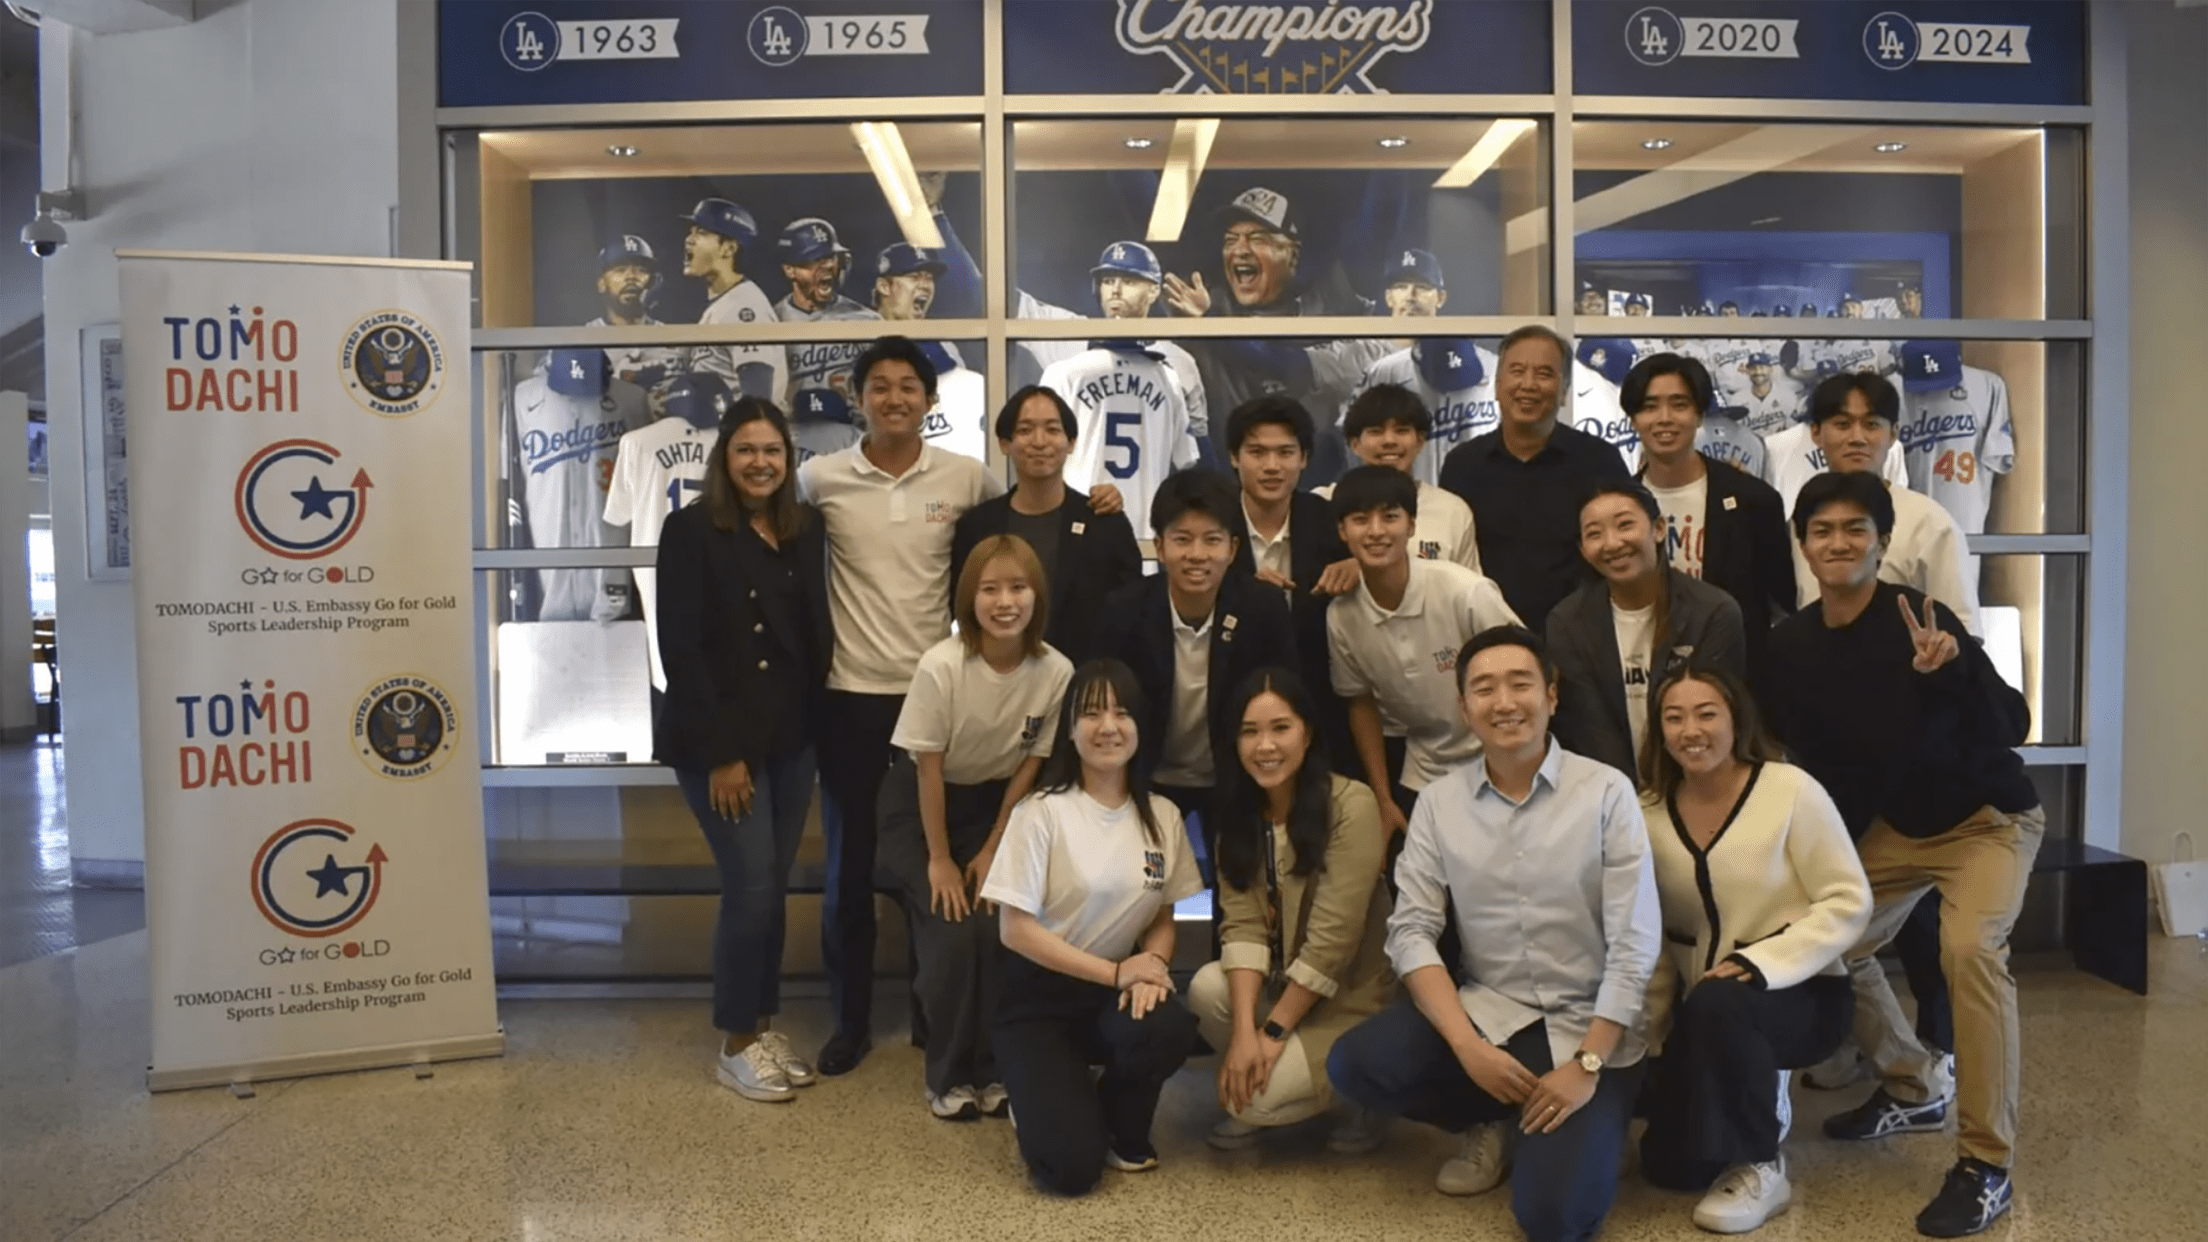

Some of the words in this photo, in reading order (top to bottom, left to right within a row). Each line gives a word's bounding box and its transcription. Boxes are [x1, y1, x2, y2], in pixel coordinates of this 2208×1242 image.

[574, 25, 658, 53] 1963
[823, 21, 907, 49] 1965
[1127, 0, 1423, 57] Champions
[1696, 23, 1781, 52] 2020
[1932, 29, 2013, 57] 2024
[163, 305, 298, 362] TOMO
[359, 314, 398, 332] STATES
[401, 316, 415, 326] OF
[788, 343, 862, 383] odgers
[166, 367, 298, 412] DACHI
[1077, 373, 1166, 411] FREEMAN
[369, 400, 419, 413] EMBASSY
[1434, 397, 1498, 443] dgers
[522, 418, 626, 465] Dodgers
[1104, 412, 1142, 479] 5
[1899, 410, 1976, 452] odgers
[655, 441, 709, 469] OHTA
[1934, 450, 1976, 484] 49
[283, 567, 303, 582] for
[156, 601, 254, 617] TOMODACHI
[272, 600, 301, 614] U.S.
[306, 598, 370, 616] Embassy
[374, 599, 394, 611] Go
[398, 596, 420, 610] for
[423, 596, 456, 610] Gold
[208, 619, 256, 636] Sports
[260, 616, 342, 635] Leadership
[347, 615, 410, 632] Program
[371, 678, 409, 697] STATES
[412, 679, 427, 688] OF
[176, 679, 310, 738] TOMO
[179, 741, 312, 790] DACHI
[382, 762, 431, 777] EMBASSY
[300, 946, 320, 961] for
[174, 986, 272, 1007] TOMODACHI
[290, 982, 319, 997] U.S.
[323, 977, 387, 997] Embassy
[391, 974, 411, 988] Go
[414, 971, 435, 985] for
[439, 968, 472, 983] Gold
[226, 1005, 275, 1022] Sports
[279, 996, 360, 1016] Leadership
[363, 990, 426, 1008] Program
